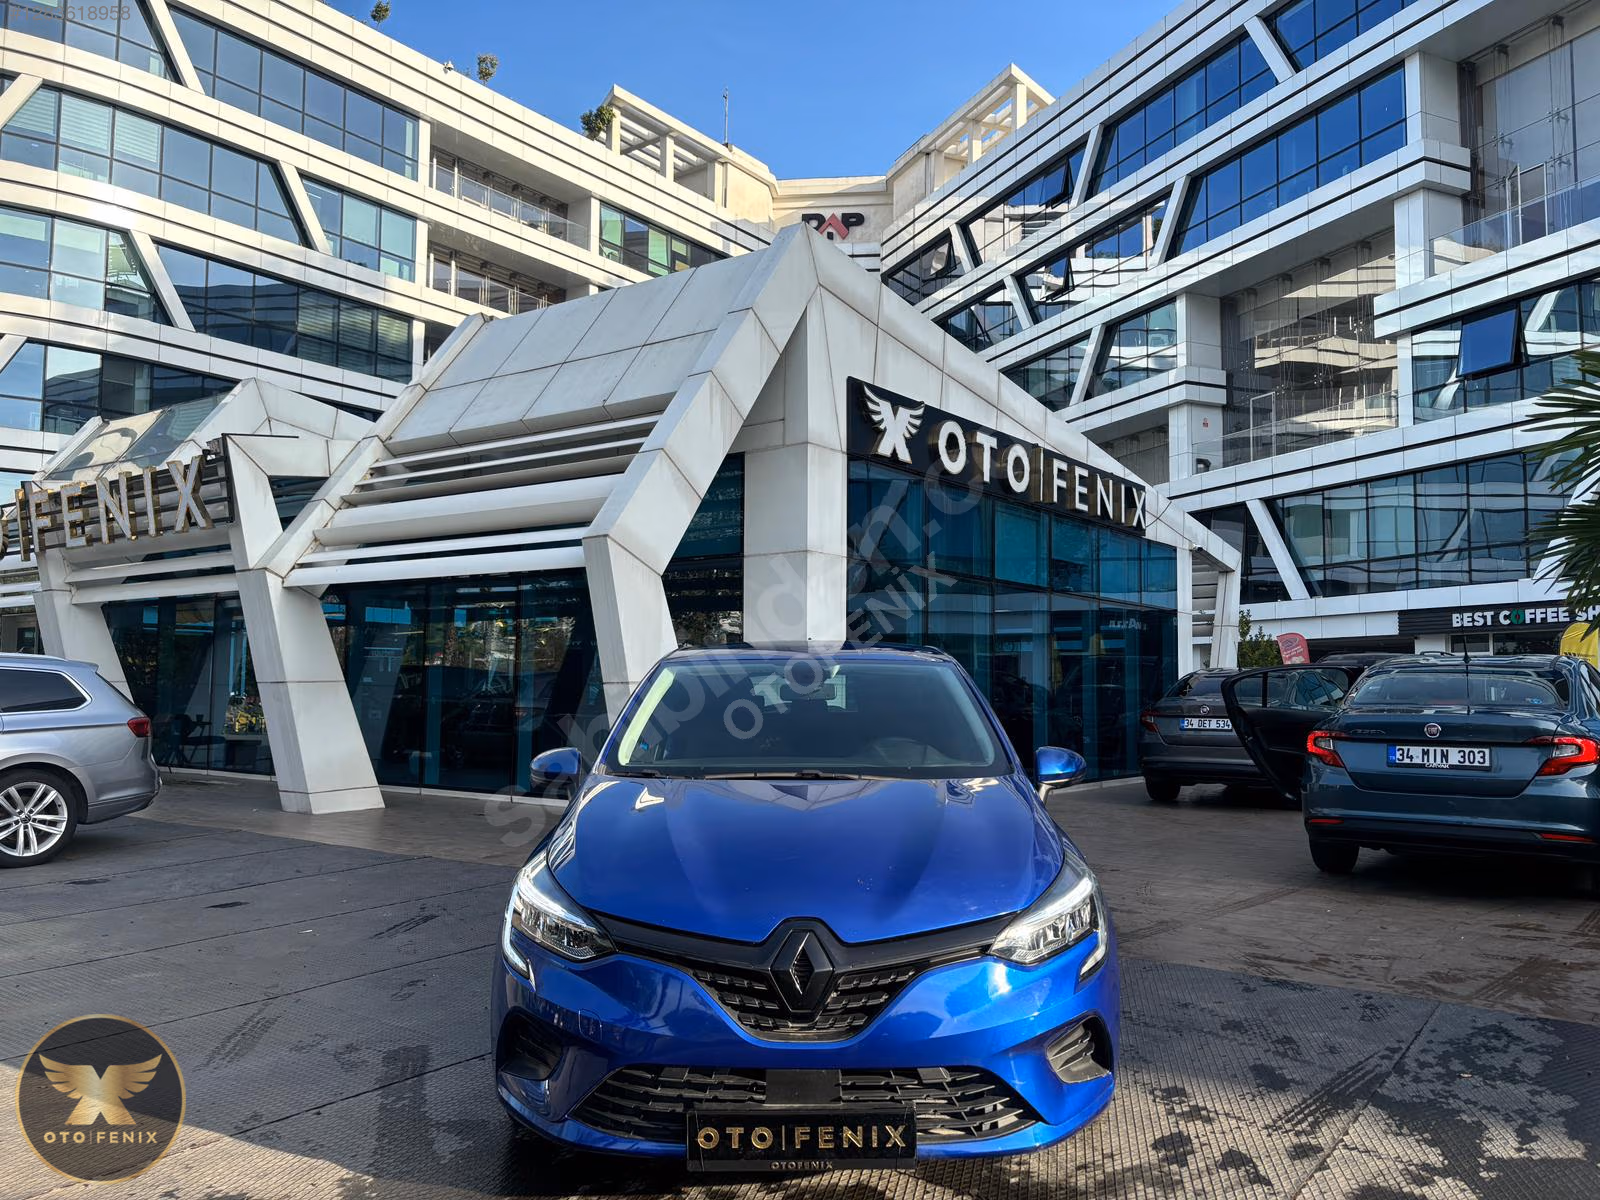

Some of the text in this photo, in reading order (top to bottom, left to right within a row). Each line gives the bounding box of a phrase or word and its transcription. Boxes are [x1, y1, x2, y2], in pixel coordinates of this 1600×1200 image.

[1451, 610, 1494, 627] BEST
[1499, 606, 1570, 625] COFFEE
[1184, 718, 1231, 729] 34 DET 534
[1396, 747, 1414, 762] 34
[1421, 748, 1449, 764] MIN
[1457, 750, 1487, 765] 303
[770, 1160, 833, 1170] OTOFENIX
